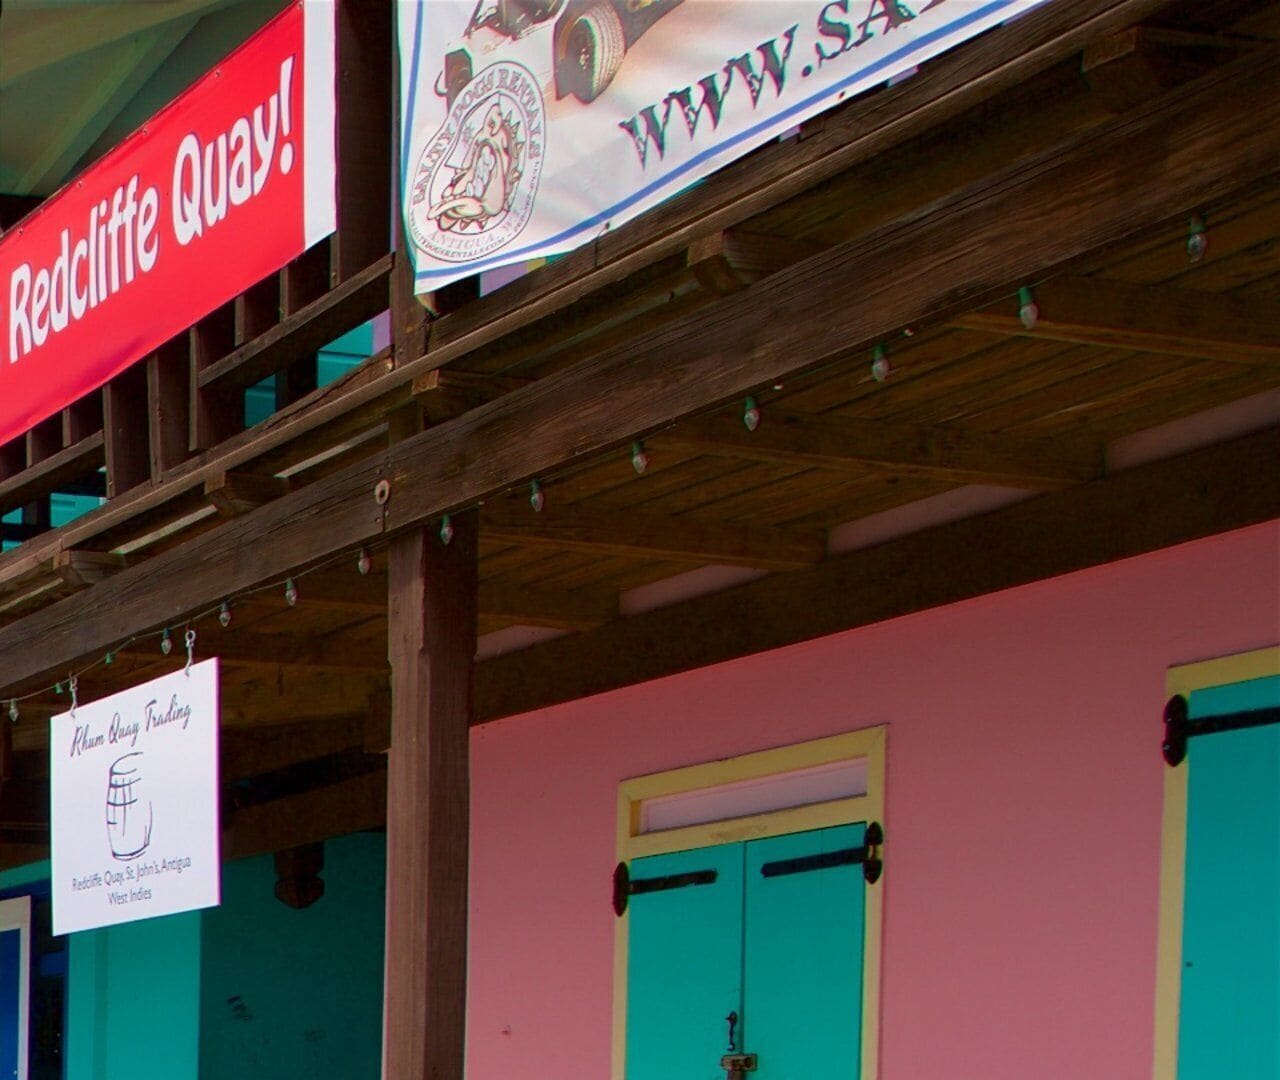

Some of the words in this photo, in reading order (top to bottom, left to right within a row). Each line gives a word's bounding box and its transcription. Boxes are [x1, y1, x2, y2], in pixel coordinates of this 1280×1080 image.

[451, 70, 495, 121] DOGS
[495, 68, 542, 159] RENTALS
[618, 0, 947, 170] WWW.SA
[10, 173, 159, 364] Redcliffe
[172, 54, 295, 246] Quay!
[70, 723, 105, 757] Rhum
[108, 711, 140, 747] Quay
[145, 693, 191, 730] Trading
[72, 873, 103, 891] Redcliffe
[160, 856, 192, 874] Antigua
[108, 891, 129, 905] West
[130, 886, 153, 903] Indies
